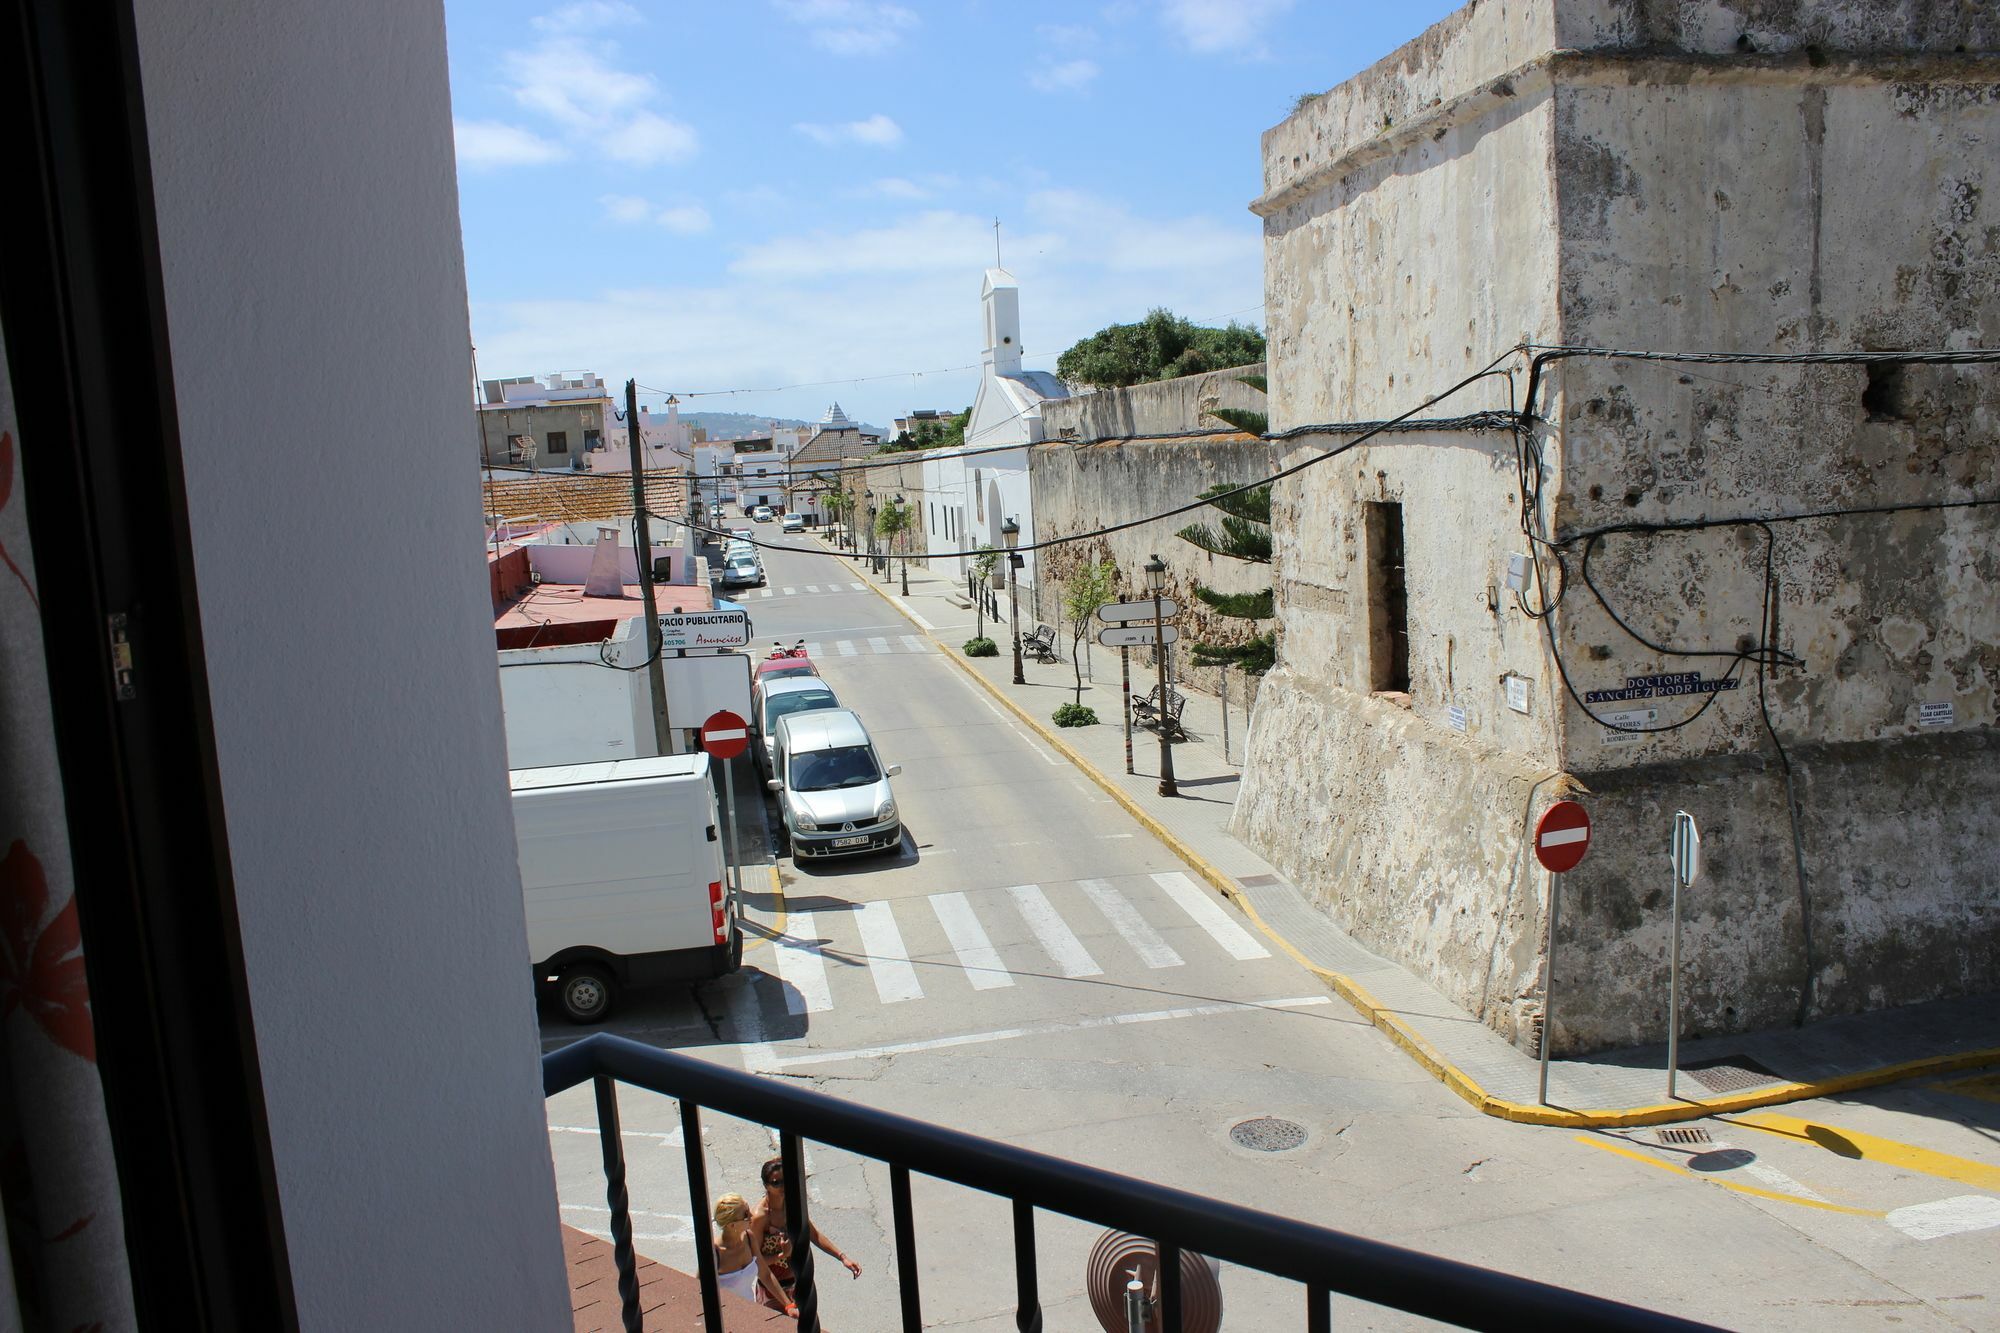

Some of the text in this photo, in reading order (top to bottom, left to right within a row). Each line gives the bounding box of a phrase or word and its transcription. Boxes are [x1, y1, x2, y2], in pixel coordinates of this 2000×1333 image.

[686, 614, 744, 626] PUBLICITARIO
[1627, 673, 1700, 689] DOCTORES
[1587, 679, 1738, 703] SANCHEZ RODRIGUEZ
